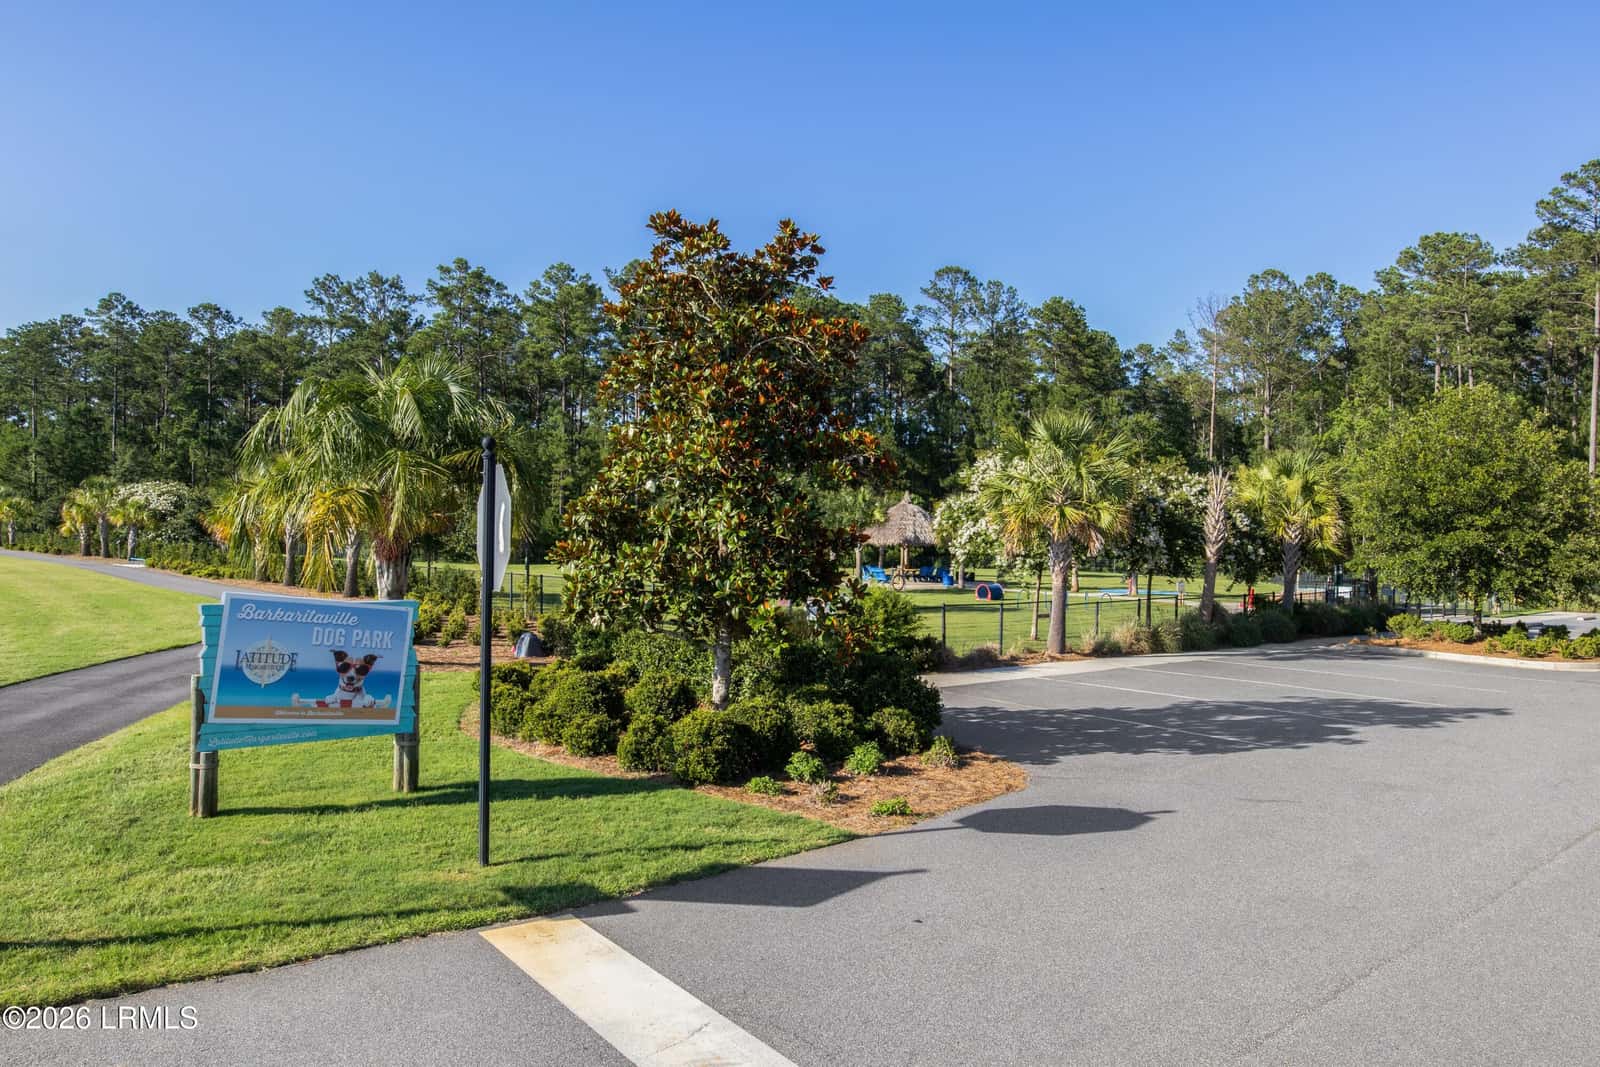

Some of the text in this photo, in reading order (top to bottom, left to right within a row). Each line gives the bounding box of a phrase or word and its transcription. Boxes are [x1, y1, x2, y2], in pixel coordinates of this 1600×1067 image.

[237, 603, 360, 626] Barkaritaville
[311, 627, 394, 649] DOG PARK
[235, 649, 298, 672] LATITUDE
